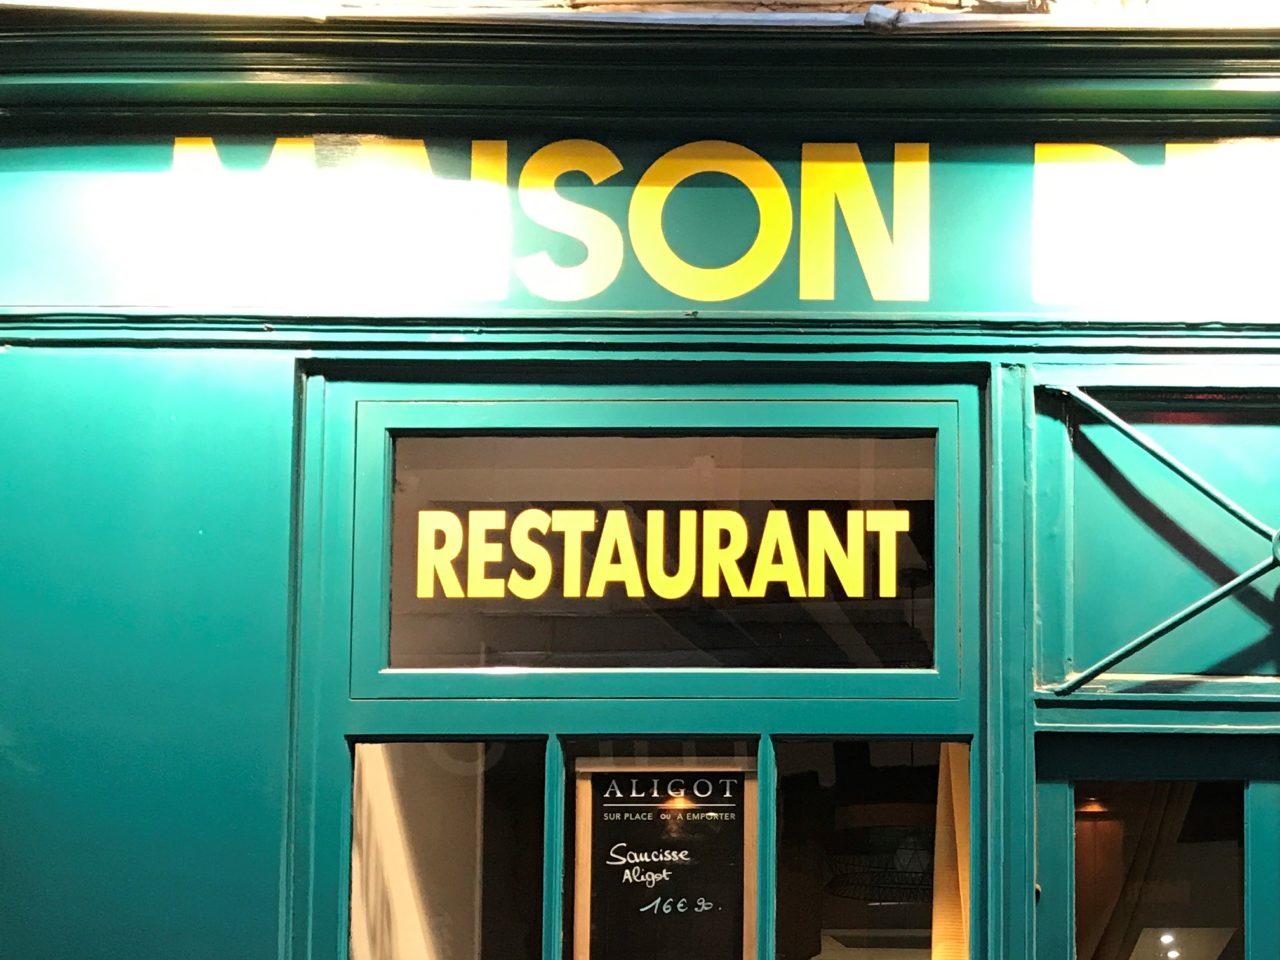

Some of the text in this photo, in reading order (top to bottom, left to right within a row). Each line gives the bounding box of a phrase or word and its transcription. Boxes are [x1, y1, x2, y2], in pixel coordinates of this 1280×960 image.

[168, 136, 931, 304] SON
[416, 508, 910, 599] RESTAURANT
[603, 778, 738, 798] ALIGOT
[603, 812, 621, 821] SUR
[624, 812, 653, 821] PLACE
[686, 812, 736, 821] EMPORTER
[606, 843, 691, 865] Saucisse
[622, 865, 673, 888] Aligot
